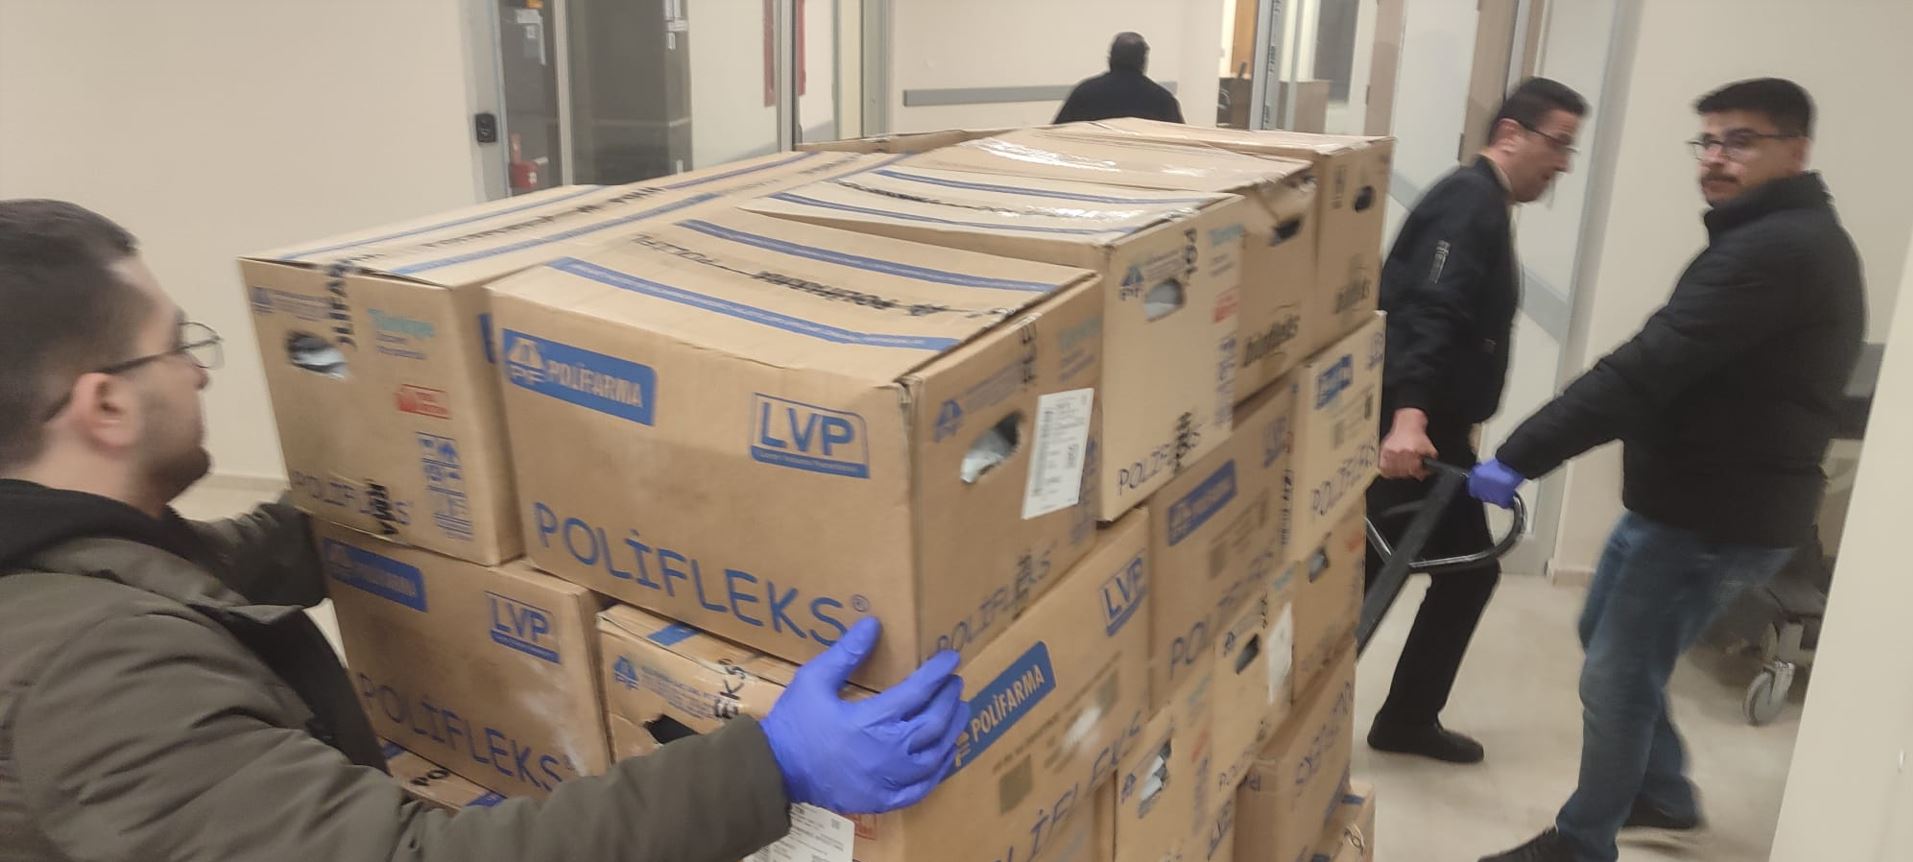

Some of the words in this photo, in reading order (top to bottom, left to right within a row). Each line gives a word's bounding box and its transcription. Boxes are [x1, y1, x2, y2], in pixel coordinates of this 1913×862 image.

[547, 359, 644, 409] POLİFARMA
[760, 402, 855, 456] LVP
[490, 597, 550, 641] LVP
[970, 664, 1045, 743] POLİFARMA
